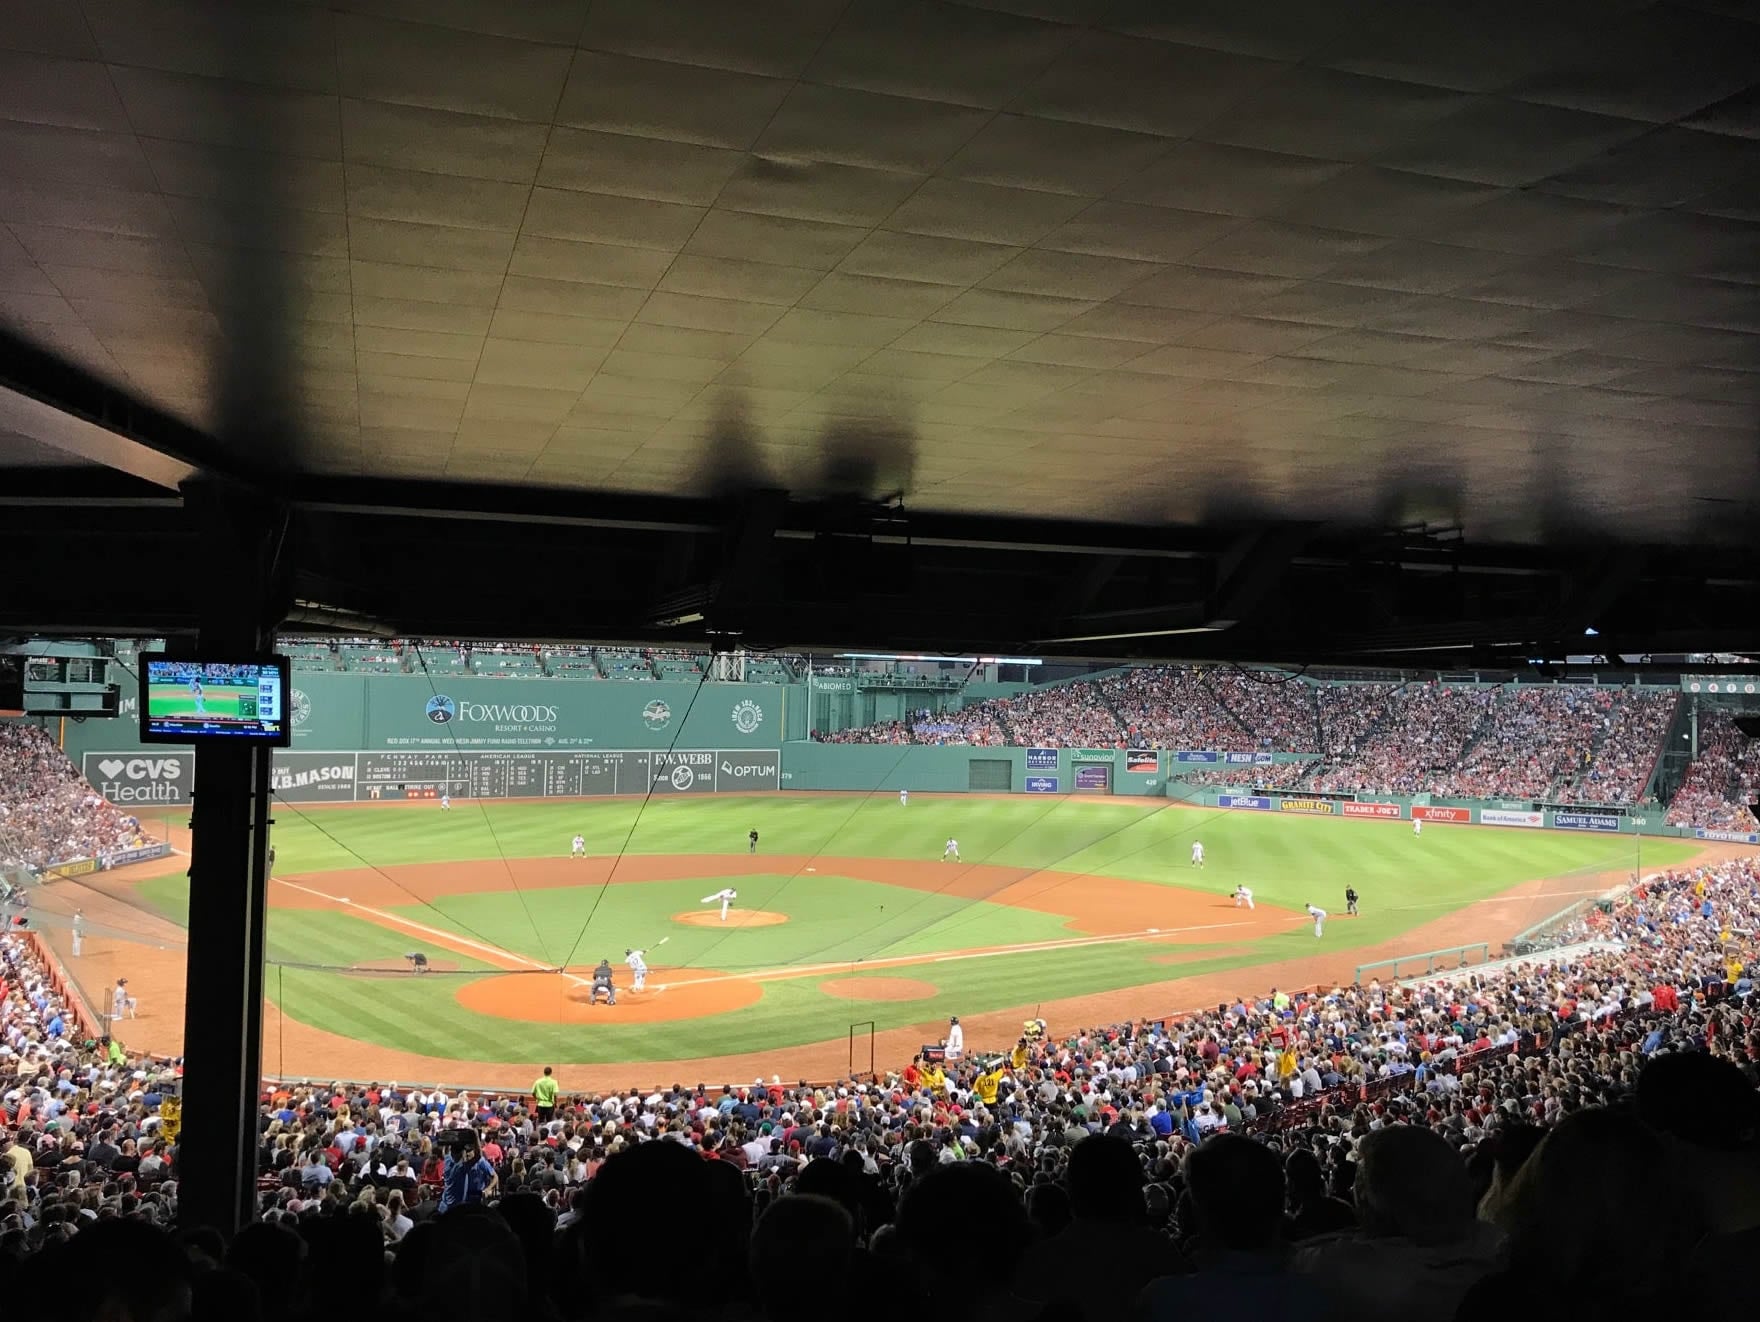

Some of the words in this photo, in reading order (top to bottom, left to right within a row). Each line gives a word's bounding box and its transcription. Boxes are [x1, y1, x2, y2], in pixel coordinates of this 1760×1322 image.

[818, 681, 852, 690] ABIOMED
[459, 701, 557, 722] FOXWOODS
[655, 754, 676, 765] F.W.
[678, 753, 712, 765] WEBB
[1080, 753, 1114, 761] sunovion
[1231, 753, 1252, 763] NESN
[126, 759, 181, 781] CVS
[734, 766, 775, 777] OPTUM
[101, 781, 180, 801] Health
[1231, 797, 1259, 807] jetBlue
[1282, 801, 1315, 809] GRANITE
[1316, 802, 1332, 813] CITY
[1345, 805, 1374, 814] TRADER
[1376, 806, 1399, 815] JOE'S
[1425, 809, 1456, 820] xfinity
[1502, 815, 1526, 823] America
[1556, 816, 1587, 825] SAMUEL
[1589, 817, 1616, 827] ADAMS
